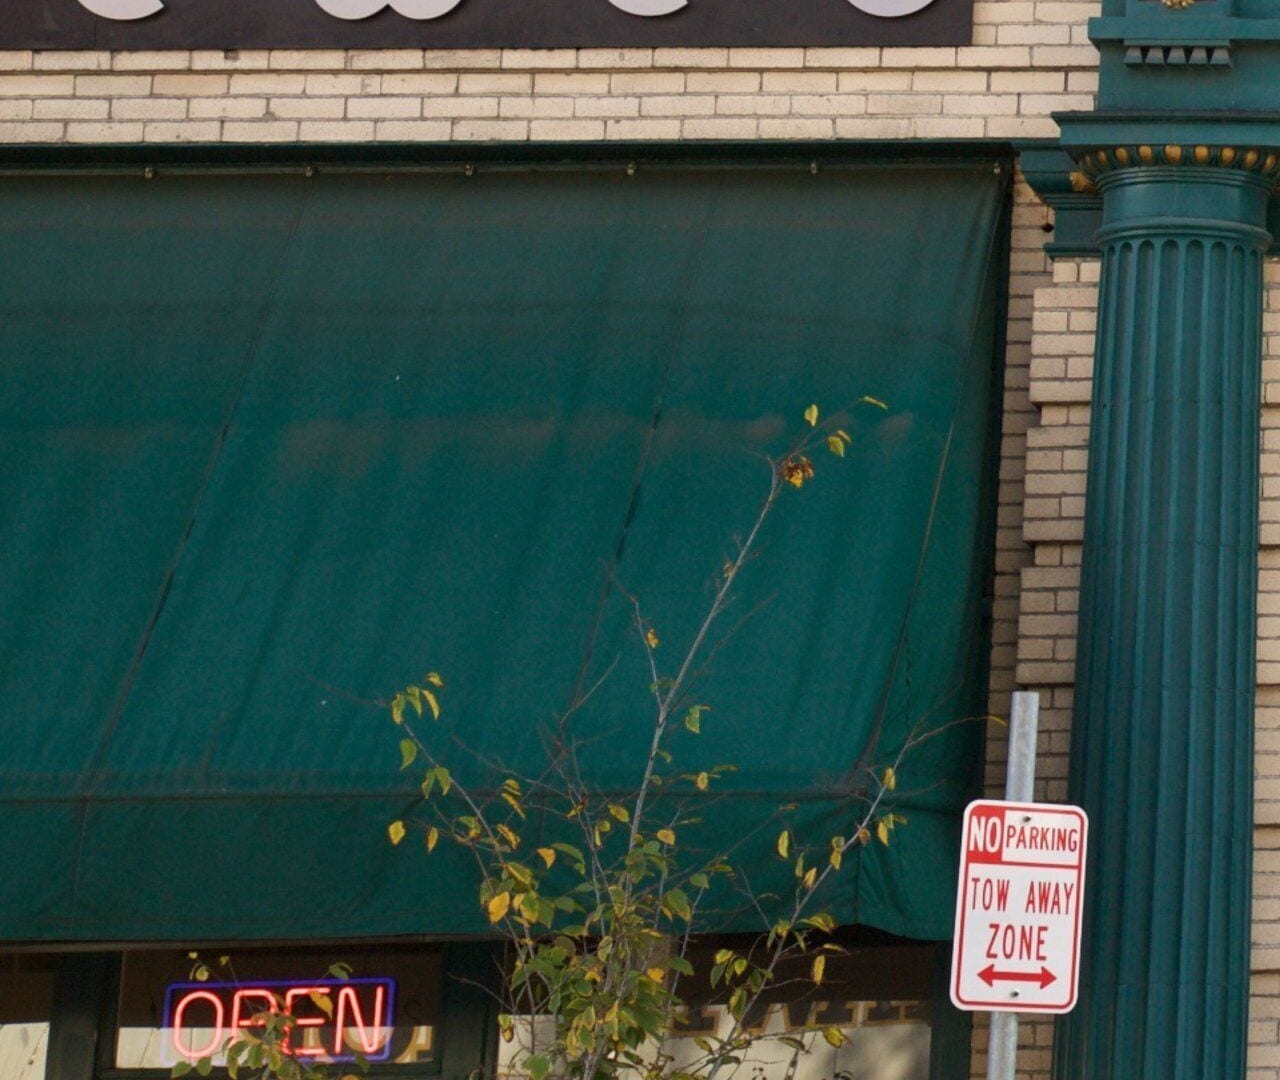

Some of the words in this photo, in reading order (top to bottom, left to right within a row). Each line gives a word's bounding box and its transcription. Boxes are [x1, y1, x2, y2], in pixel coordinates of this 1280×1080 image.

[968, 816, 1001, 853] NO
[1006, 825, 1078, 852] PARKING
[971, 878, 1010, 912] TOW
[1024, 881, 1074, 915] AWAY
[985, 923, 1048, 961] ZONE
[173, 985, 384, 1059] OPEN
